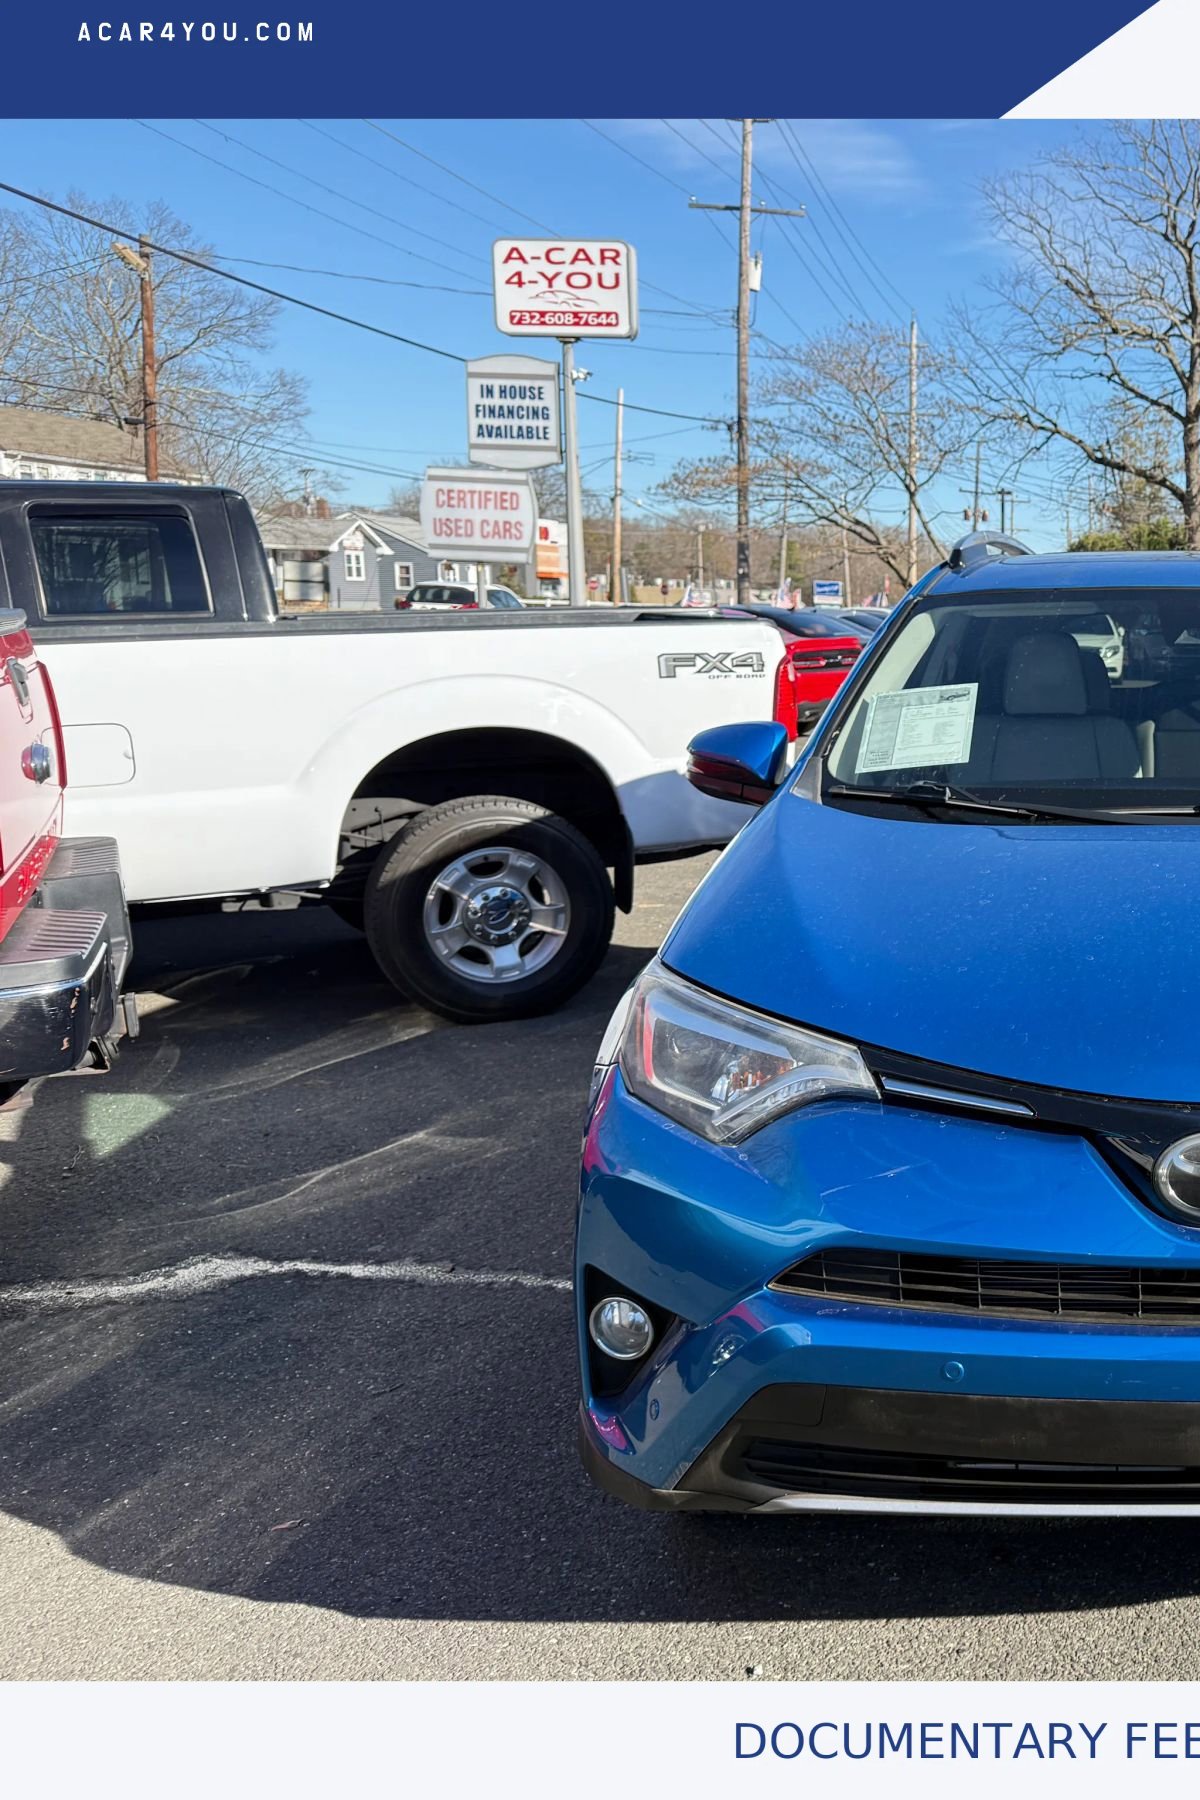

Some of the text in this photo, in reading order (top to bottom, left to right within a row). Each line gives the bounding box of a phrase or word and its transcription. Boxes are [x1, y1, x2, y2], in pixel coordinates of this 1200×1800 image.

[503, 246, 622, 266] A-CAR
[505, 271, 620, 290] 4-YOU
[511, 311, 618, 326] 732-608-7644
[480, 384, 545, 401] IN HOUSE
[475, 404, 550, 421] FINANCING
[477, 424, 550, 441] AVAILABLE
[436, 488, 520, 511] CERTIFIED
[433, 518, 524, 541] USED CARS
[658, 652, 765, 678] FX4
